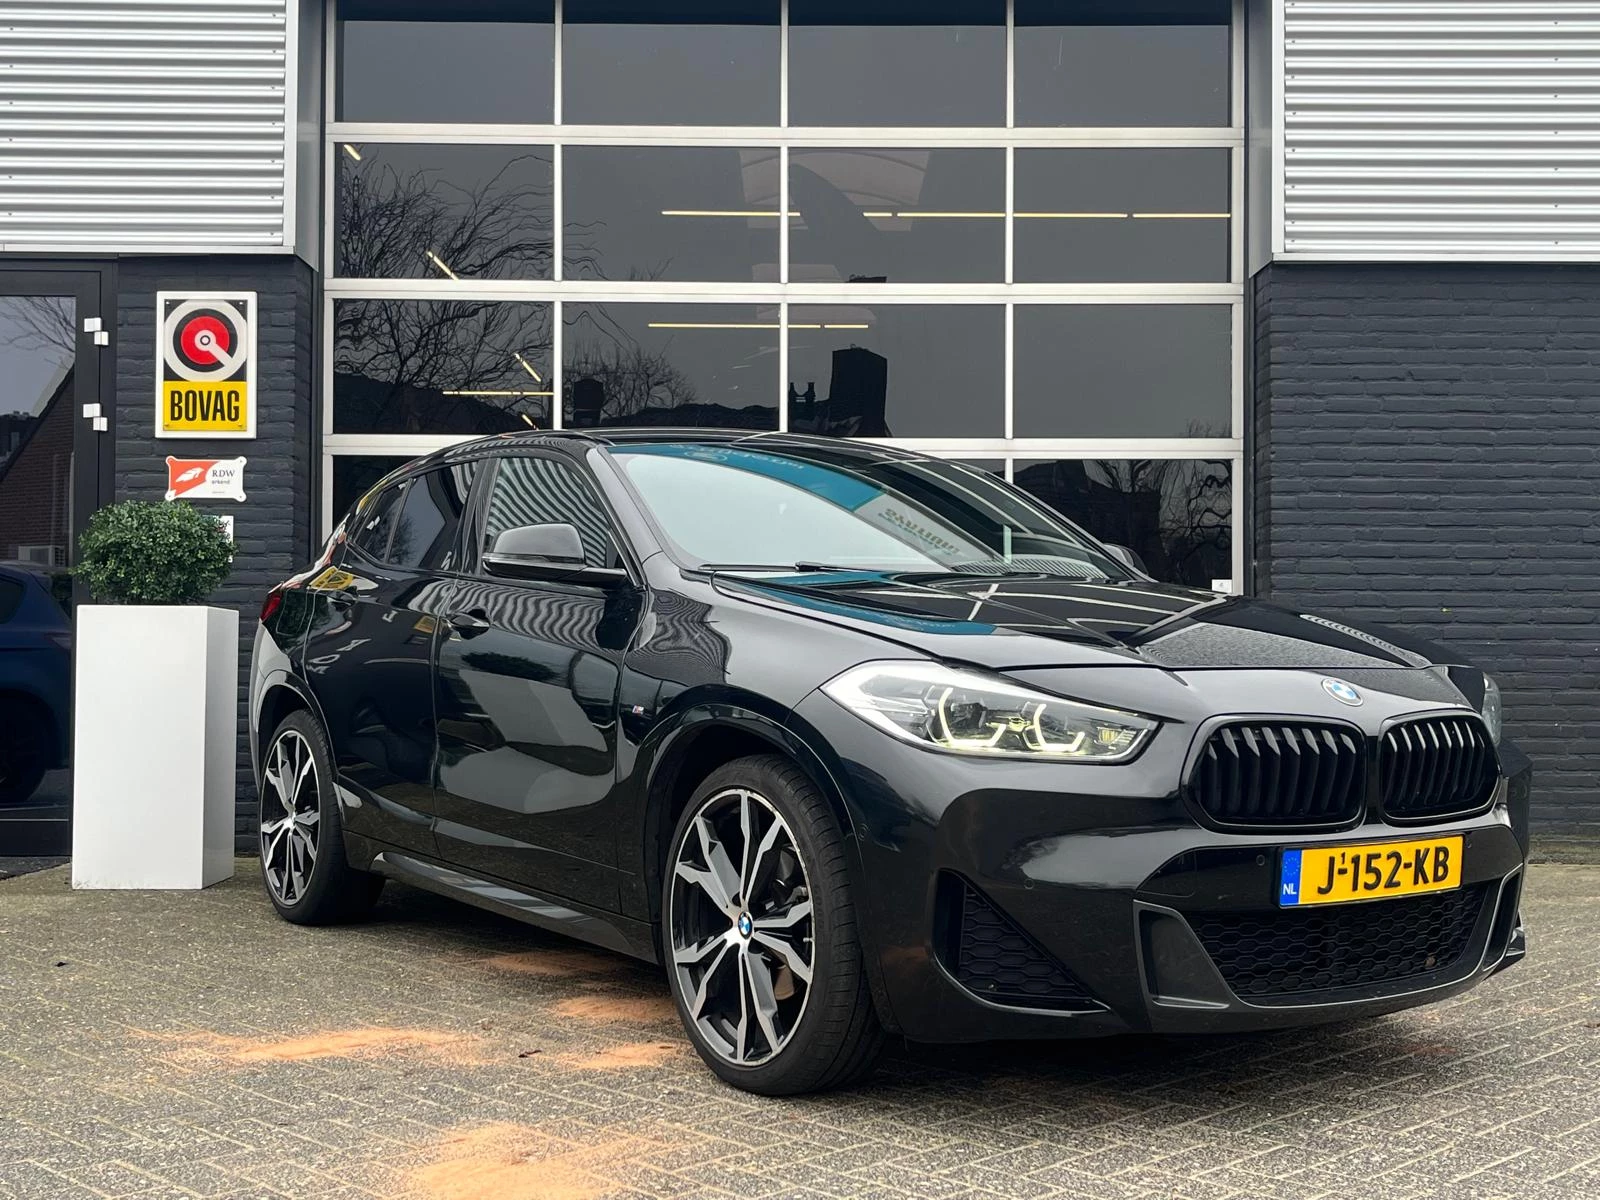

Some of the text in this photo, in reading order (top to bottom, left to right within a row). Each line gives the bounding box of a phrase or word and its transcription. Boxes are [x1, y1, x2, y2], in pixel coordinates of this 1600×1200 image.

[170, 389, 240, 422] BOVAG
[212, 469, 235, 478] RDW
[1282, 883, 1297, 895] NL
